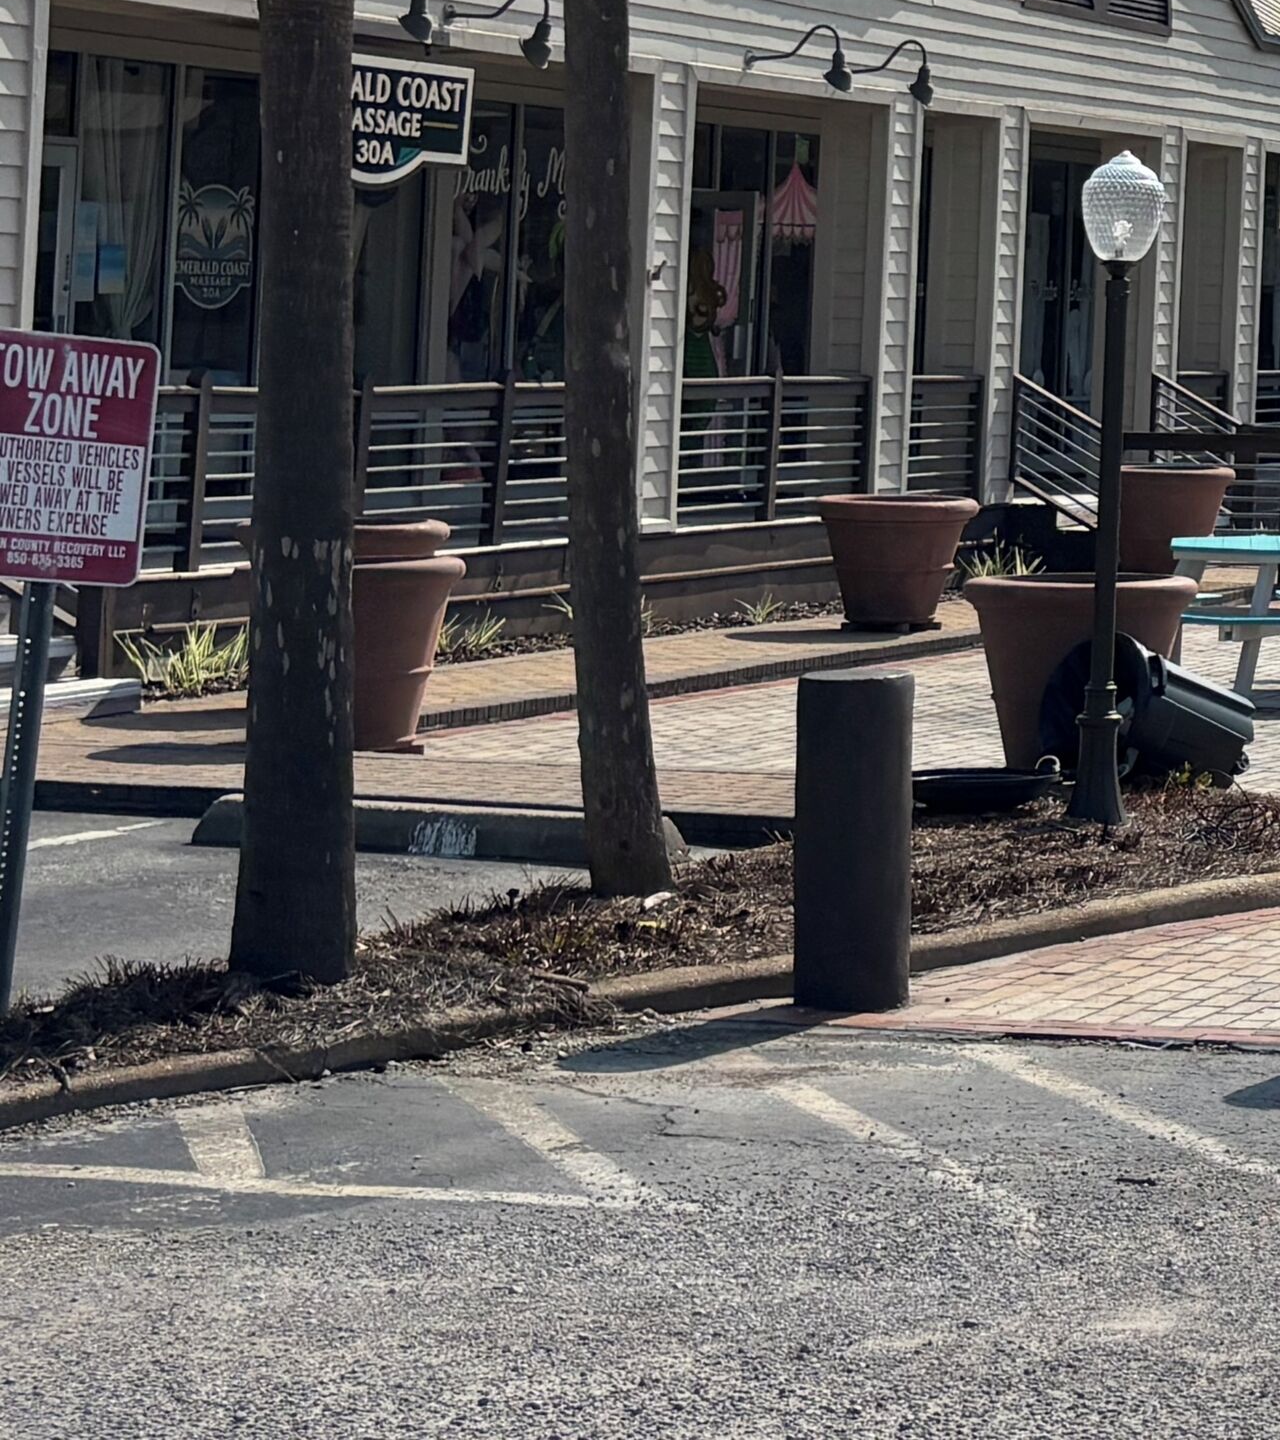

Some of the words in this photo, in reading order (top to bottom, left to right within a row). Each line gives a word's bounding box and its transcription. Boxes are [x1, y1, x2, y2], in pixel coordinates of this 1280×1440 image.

[397, 77, 465, 112] COAST
[355, 140, 395, 165] 30A
[220, 262, 250, 276] COAST
[60, 350, 145, 399] AWAY
[24, 391, 101, 439] ZONE
[78, 444, 139, 471] VEHICLES
[7, 461, 66, 487] VESSELS
[72, 466, 101, 490] WILL
[107, 470, 124, 492] BE
[33, 486, 71, 510] AWAY
[75, 490, 92, 512] AT
[97, 492, 121, 514] THE
[47, 511, 108, 536] EXPENSE
[11, 538, 50, 553] COUNTY
[53, 541, 105, 557] RECOVERY
[108, 545, 126, 558] LLC
